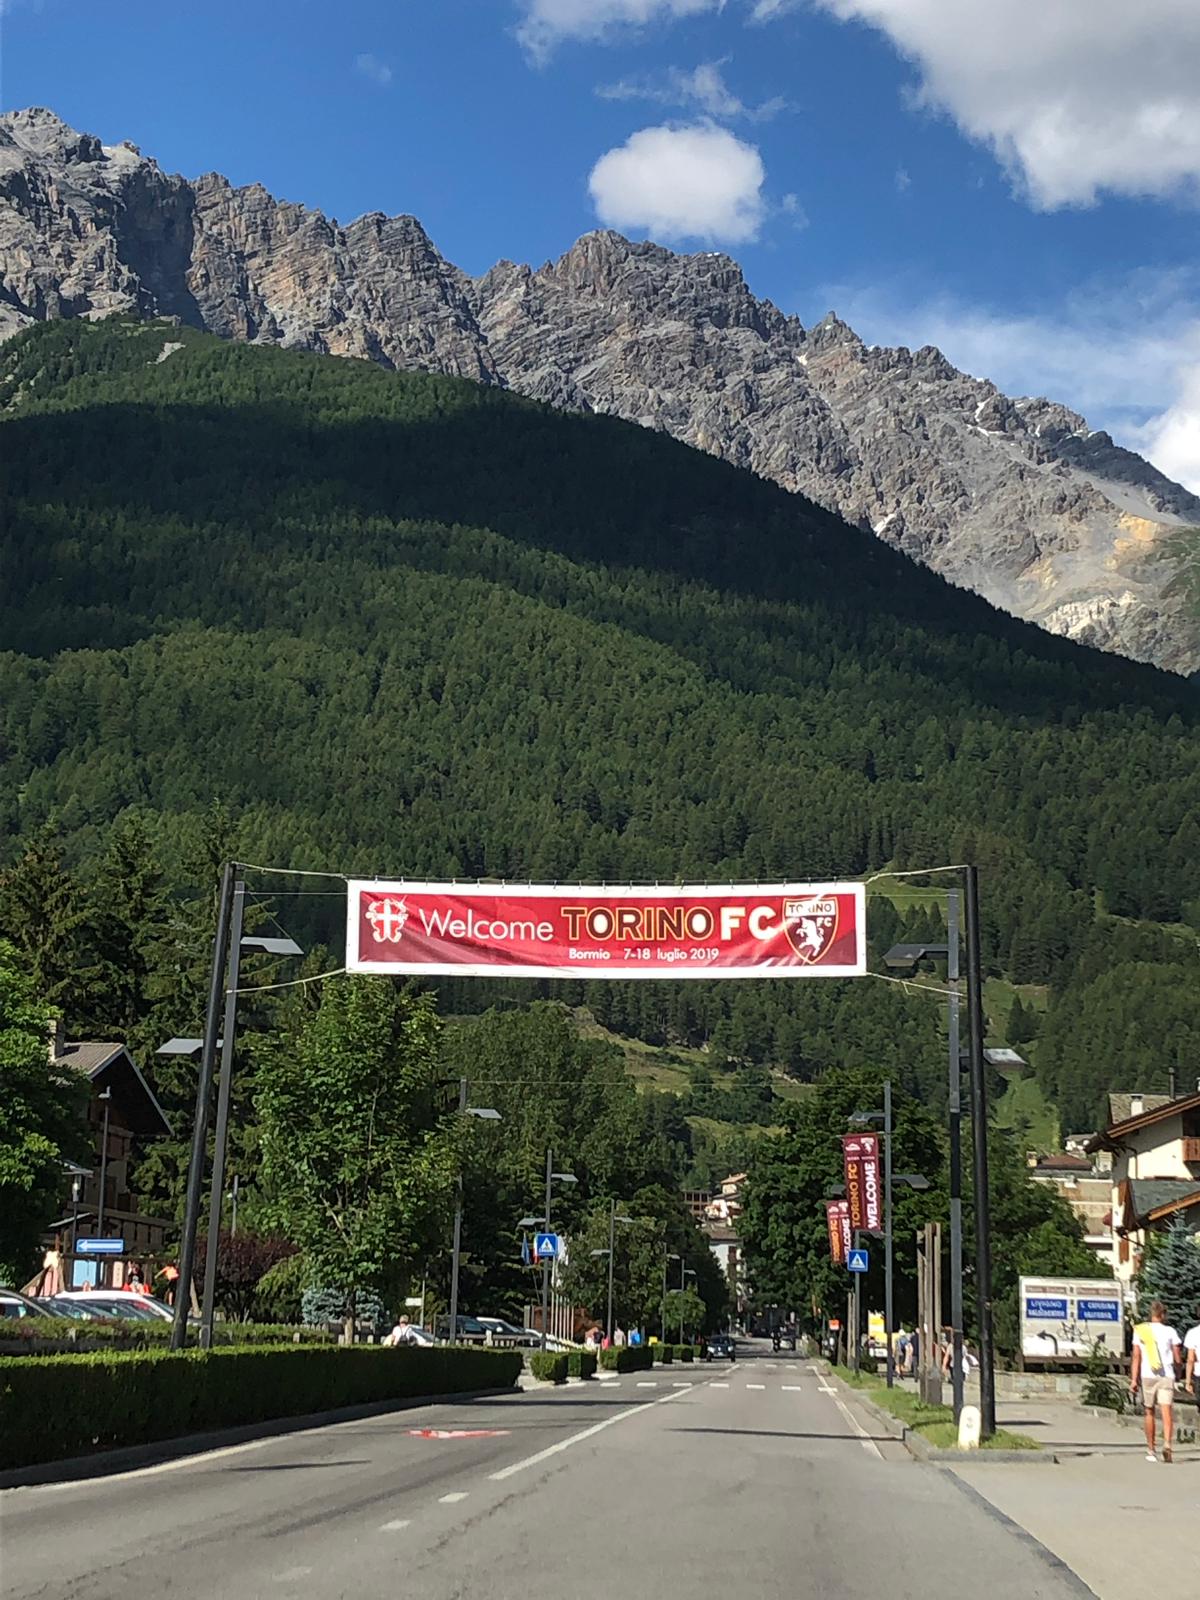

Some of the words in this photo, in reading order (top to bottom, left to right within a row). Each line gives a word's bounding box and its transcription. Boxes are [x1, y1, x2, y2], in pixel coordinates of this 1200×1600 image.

[418, 908, 554, 941] Welcome
[561, 906, 714, 941] TORINO
[720, 905, 777, 941] FC
[816, 917, 832, 927] FC
[568, 948, 611, 960] Bormio
[623, 948, 651, 960] 7-18
[656, 948, 688, 962] luglio
[690, 948, 720, 960] 2019
[847, 1163, 858, 1180] FC
[850, 1182, 861, 1228] TORINO
[864, 1161, 878, 1229] WELCOME
